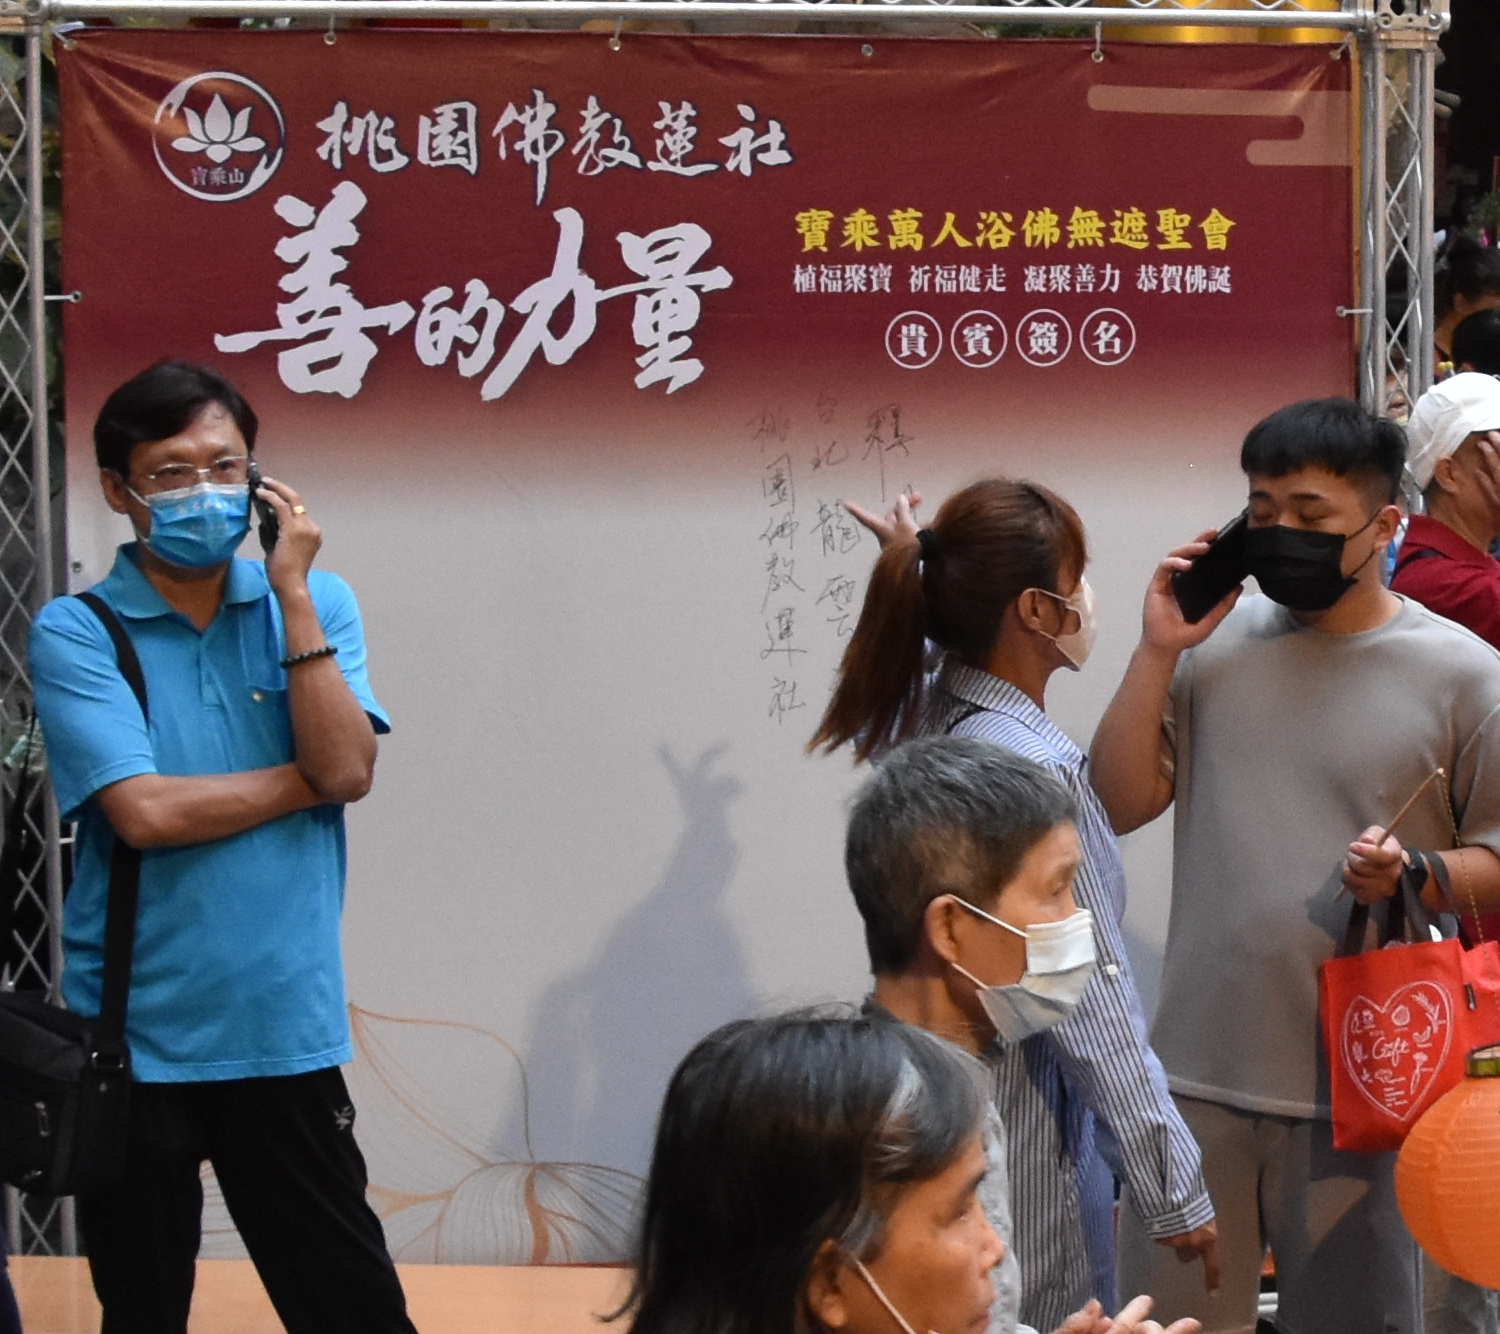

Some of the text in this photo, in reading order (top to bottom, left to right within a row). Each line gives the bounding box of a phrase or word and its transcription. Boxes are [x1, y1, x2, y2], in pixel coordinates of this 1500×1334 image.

[315, 88, 794, 205] 桃園佛教蓮社
[795, 206, 1237, 252] 寶乘萬人浴佛無遮聖會
[213, 180, 734, 401] 善的力量
[793, 263, 1233, 294] 植福聚寶 祈福健走 凝聚善力 恭賀佛誕
